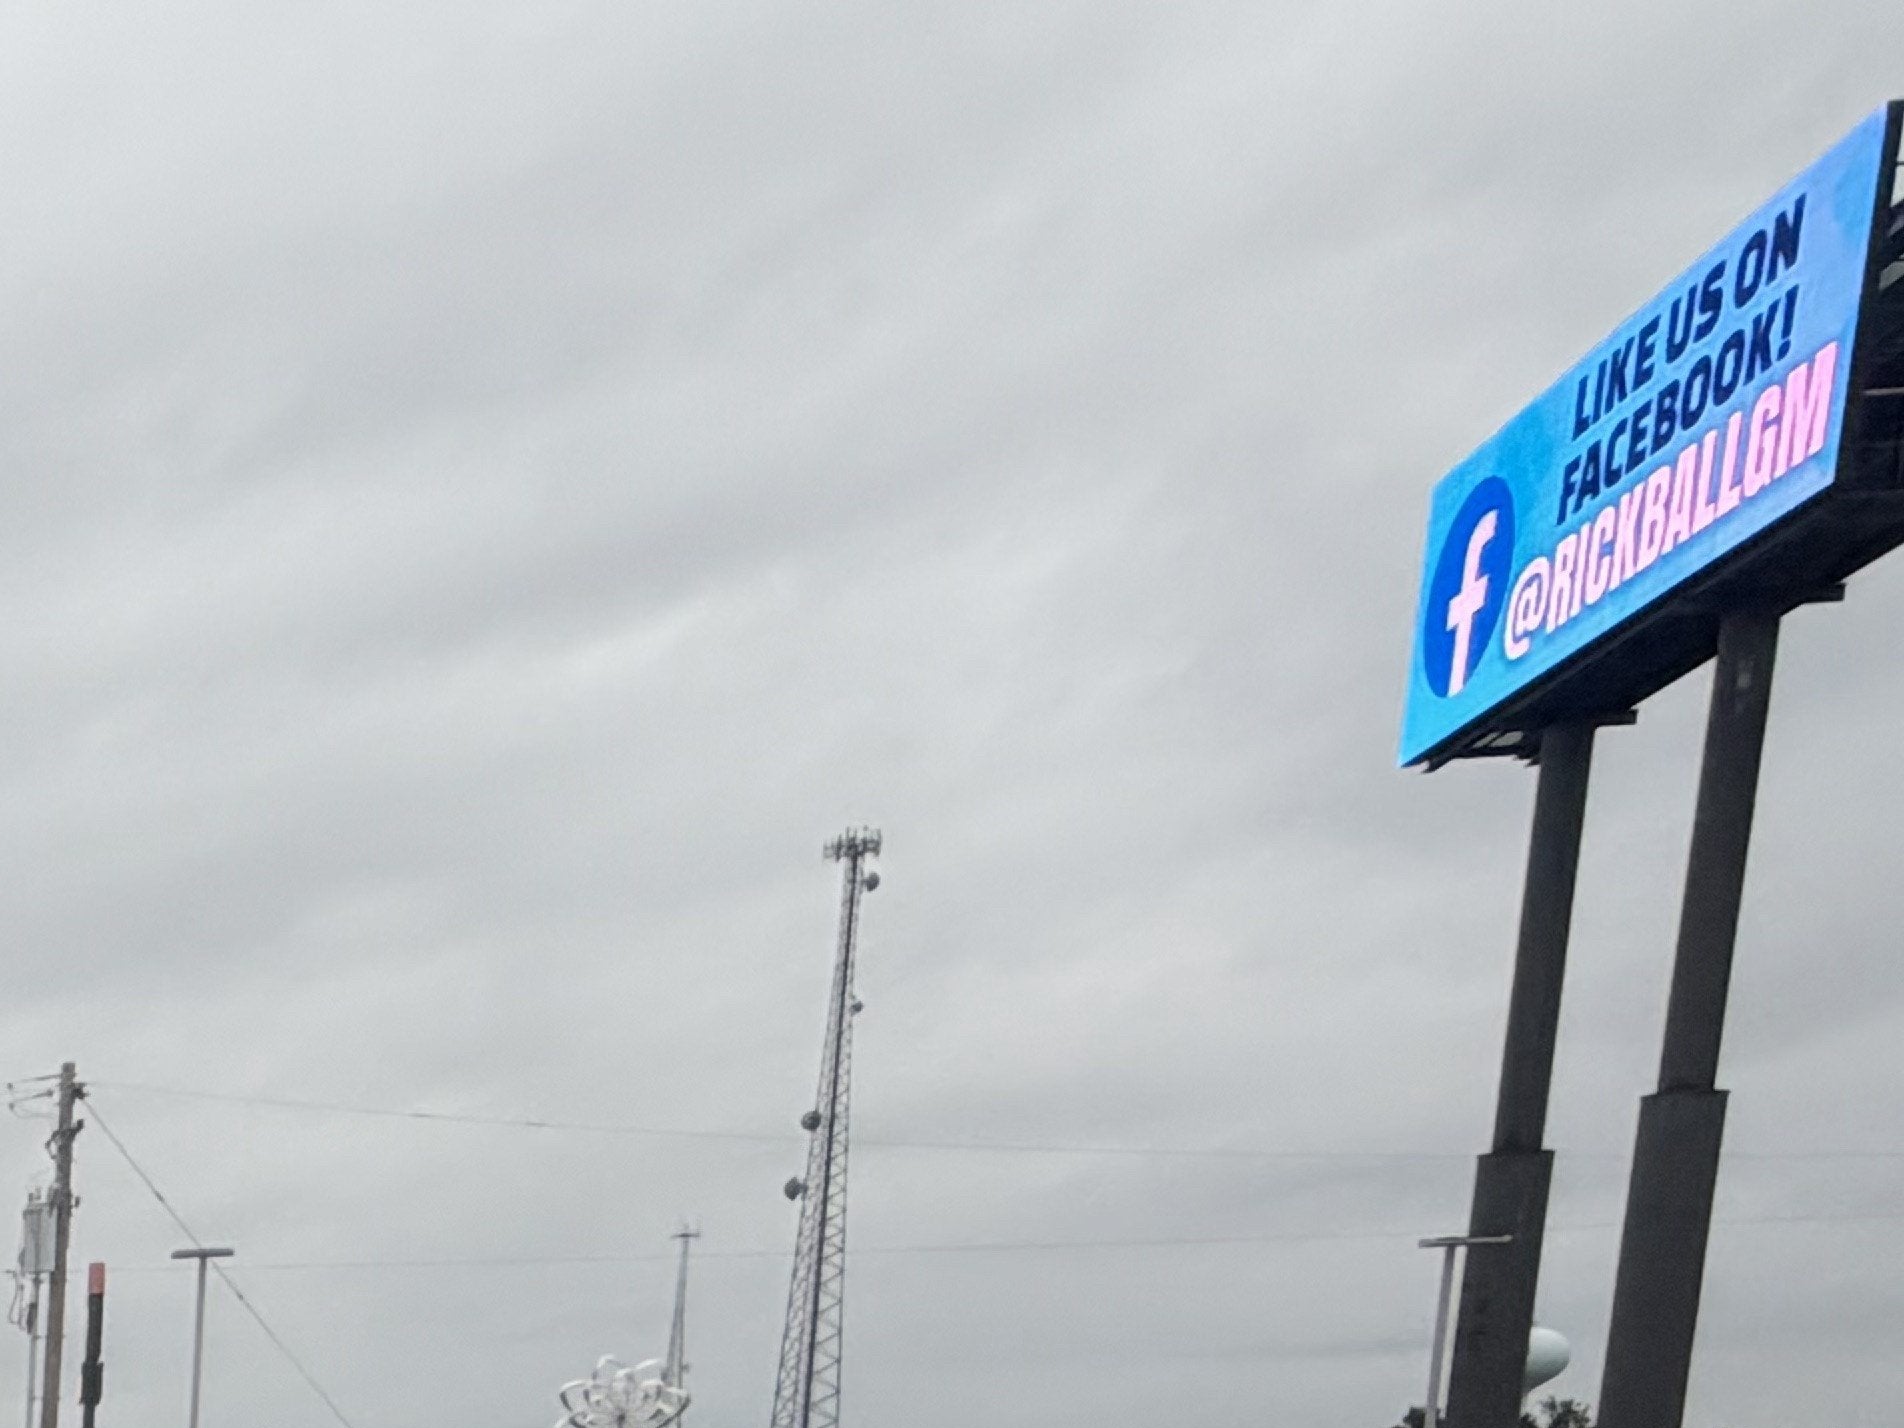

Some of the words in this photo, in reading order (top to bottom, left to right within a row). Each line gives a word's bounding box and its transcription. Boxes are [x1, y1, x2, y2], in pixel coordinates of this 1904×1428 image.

[1556, 283, 1800, 527] FACEBOOK!
[1572, 314, 1661, 441] LIKE
[1666, 259, 1727, 364] US
[1735, 192, 1807, 308] ON
[1502, 340, 1839, 660] @RICKBALLGM
